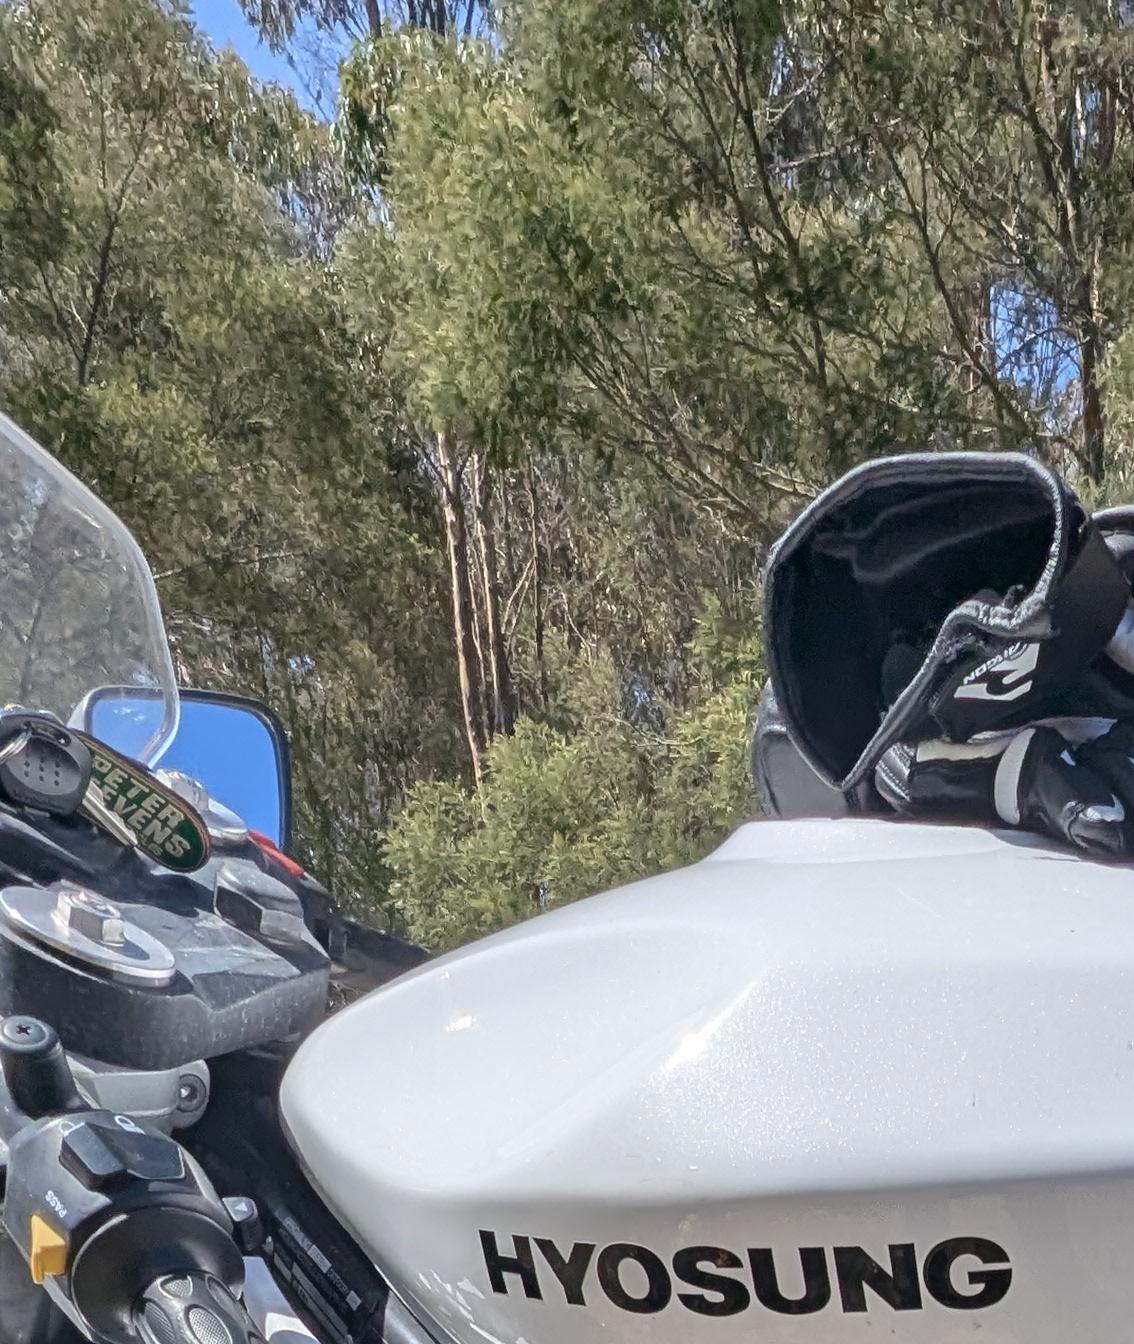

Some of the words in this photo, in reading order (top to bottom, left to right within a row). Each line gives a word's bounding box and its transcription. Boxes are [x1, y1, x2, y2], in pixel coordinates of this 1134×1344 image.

[92, 755, 185, 828] PETER
[92, 778, 190, 858] EVENS
[45, 1190, 67, 1218] PASS
[479, 1229, 1013, 1317] HYOSUNG
